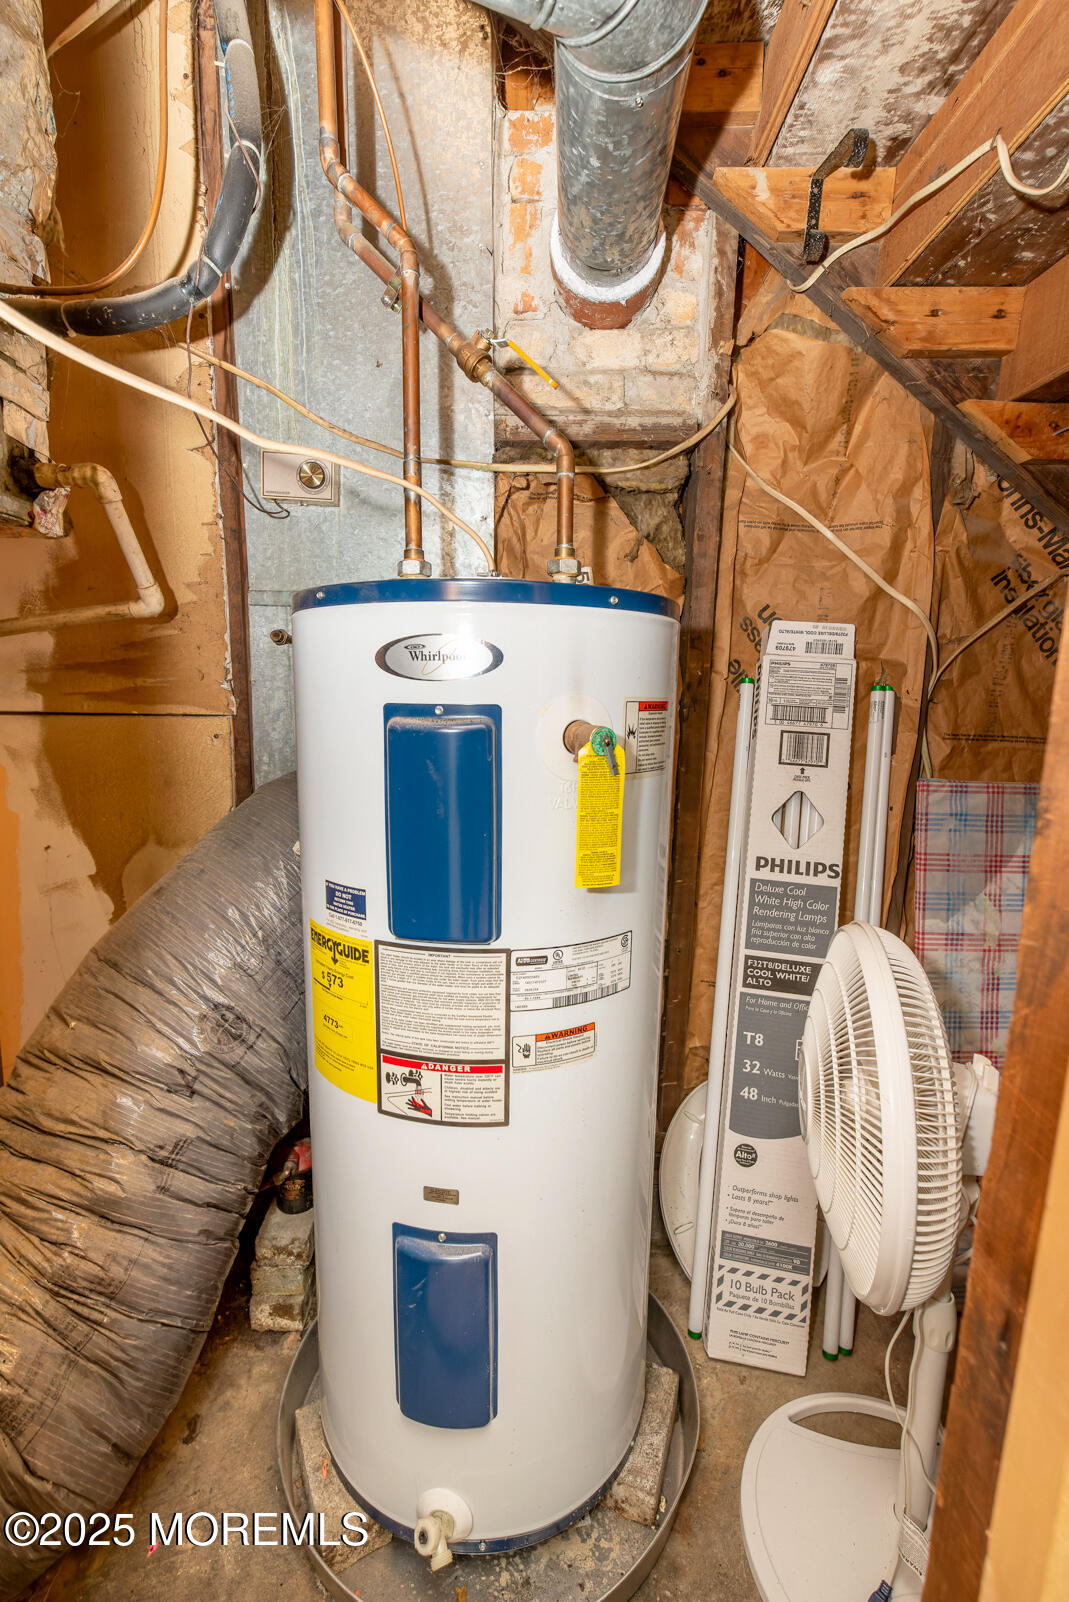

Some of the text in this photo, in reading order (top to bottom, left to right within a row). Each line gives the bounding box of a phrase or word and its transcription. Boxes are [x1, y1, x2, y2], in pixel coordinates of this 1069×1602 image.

[408, 650, 466, 664] Whirlpoo
[755, 856, 840, 879] PHILIPS
[755, 882, 806, 896] Deluxe Cool
[754, 894, 829, 910] White High Color
[753, 906, 827, 924] Rendering Lamps
[748, 960, 811, 974] F32T8/DELUXE
[326, 972, 343, 988] 573
[746, 978, 772, 986] ALTO
[747, 968, 809, 982] COOL WHITE/
[758, 998, 777, 1006] Home
[794, 1002, 809, 1012] Offic
[552, 1025, 588, 1038] WARNING
[744, 1032, 764, 1046] T8
[428, 1064, 471, 1072] DANGER
[742, 1060, 760, 1073] 32
[764, 1068, 785, 1078] Watts
[740, 1086, 758, 1100] 48
[761, 1095, 776, 1103] Inch
[732, 1185, 767, 1197] Outperforms
[769, 1192, 782, 1200] shop
[729, 1291, 750, 1300] Paquete
[730, 1279, 795, 1301] 10 Bulb Pack
